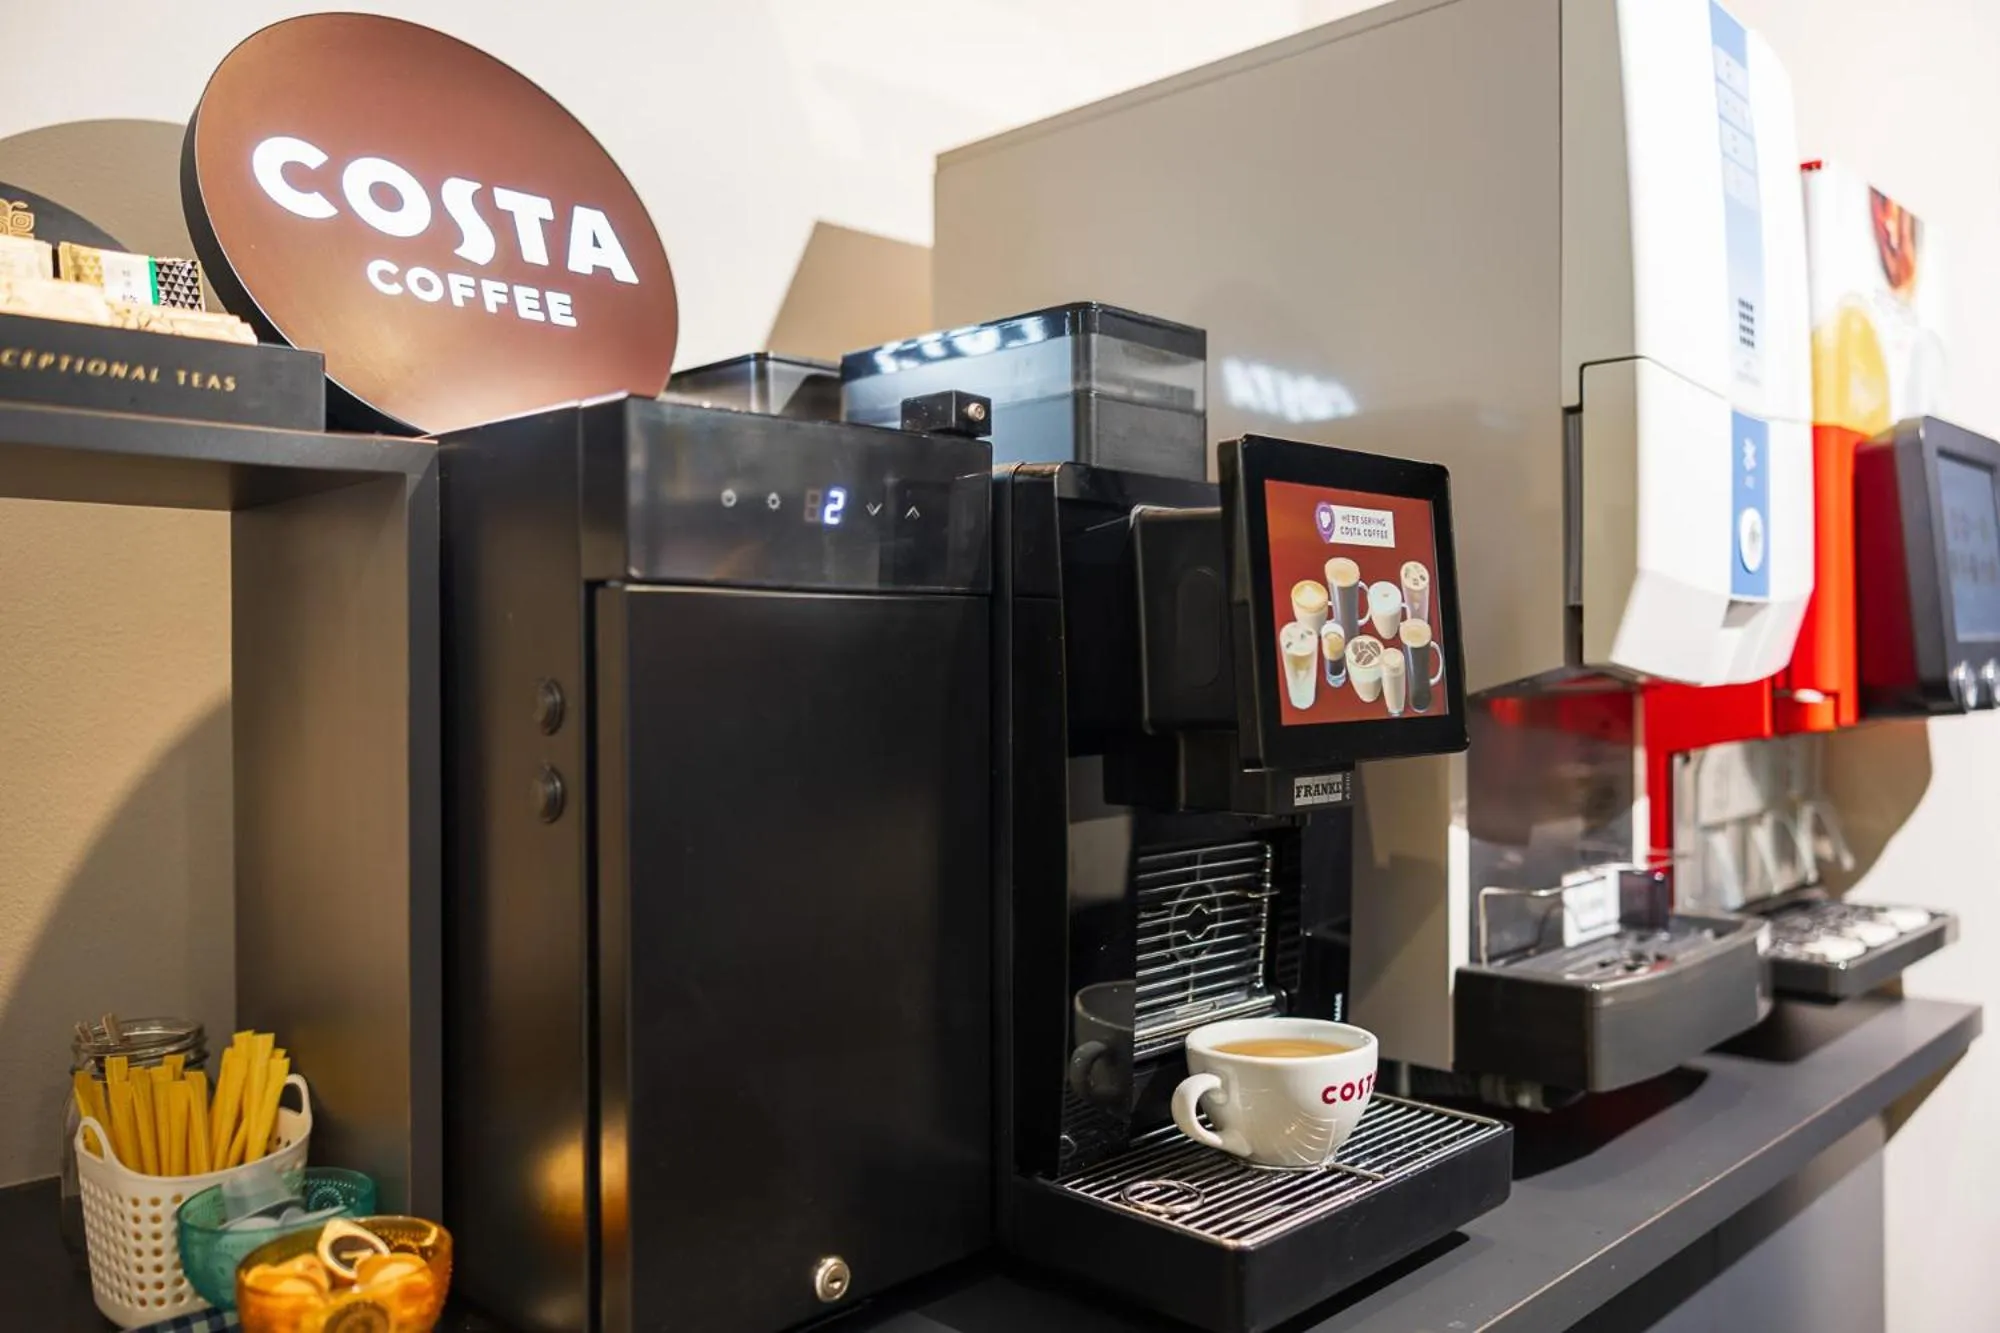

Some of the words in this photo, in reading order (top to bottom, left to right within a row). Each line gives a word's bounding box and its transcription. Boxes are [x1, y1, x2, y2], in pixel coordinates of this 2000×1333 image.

[252, 136, 640, 284] COSTA
[366, 259, 577, 328] COFFEE
[175, 368, 237, 392] TEAS
[823, 487, 847, 525] 2
[1360, 516, 1386, 527] SERVING
[1340, 525, 1361, 537] COSTA
[1363, 528, 1388, 540] COFFEE
